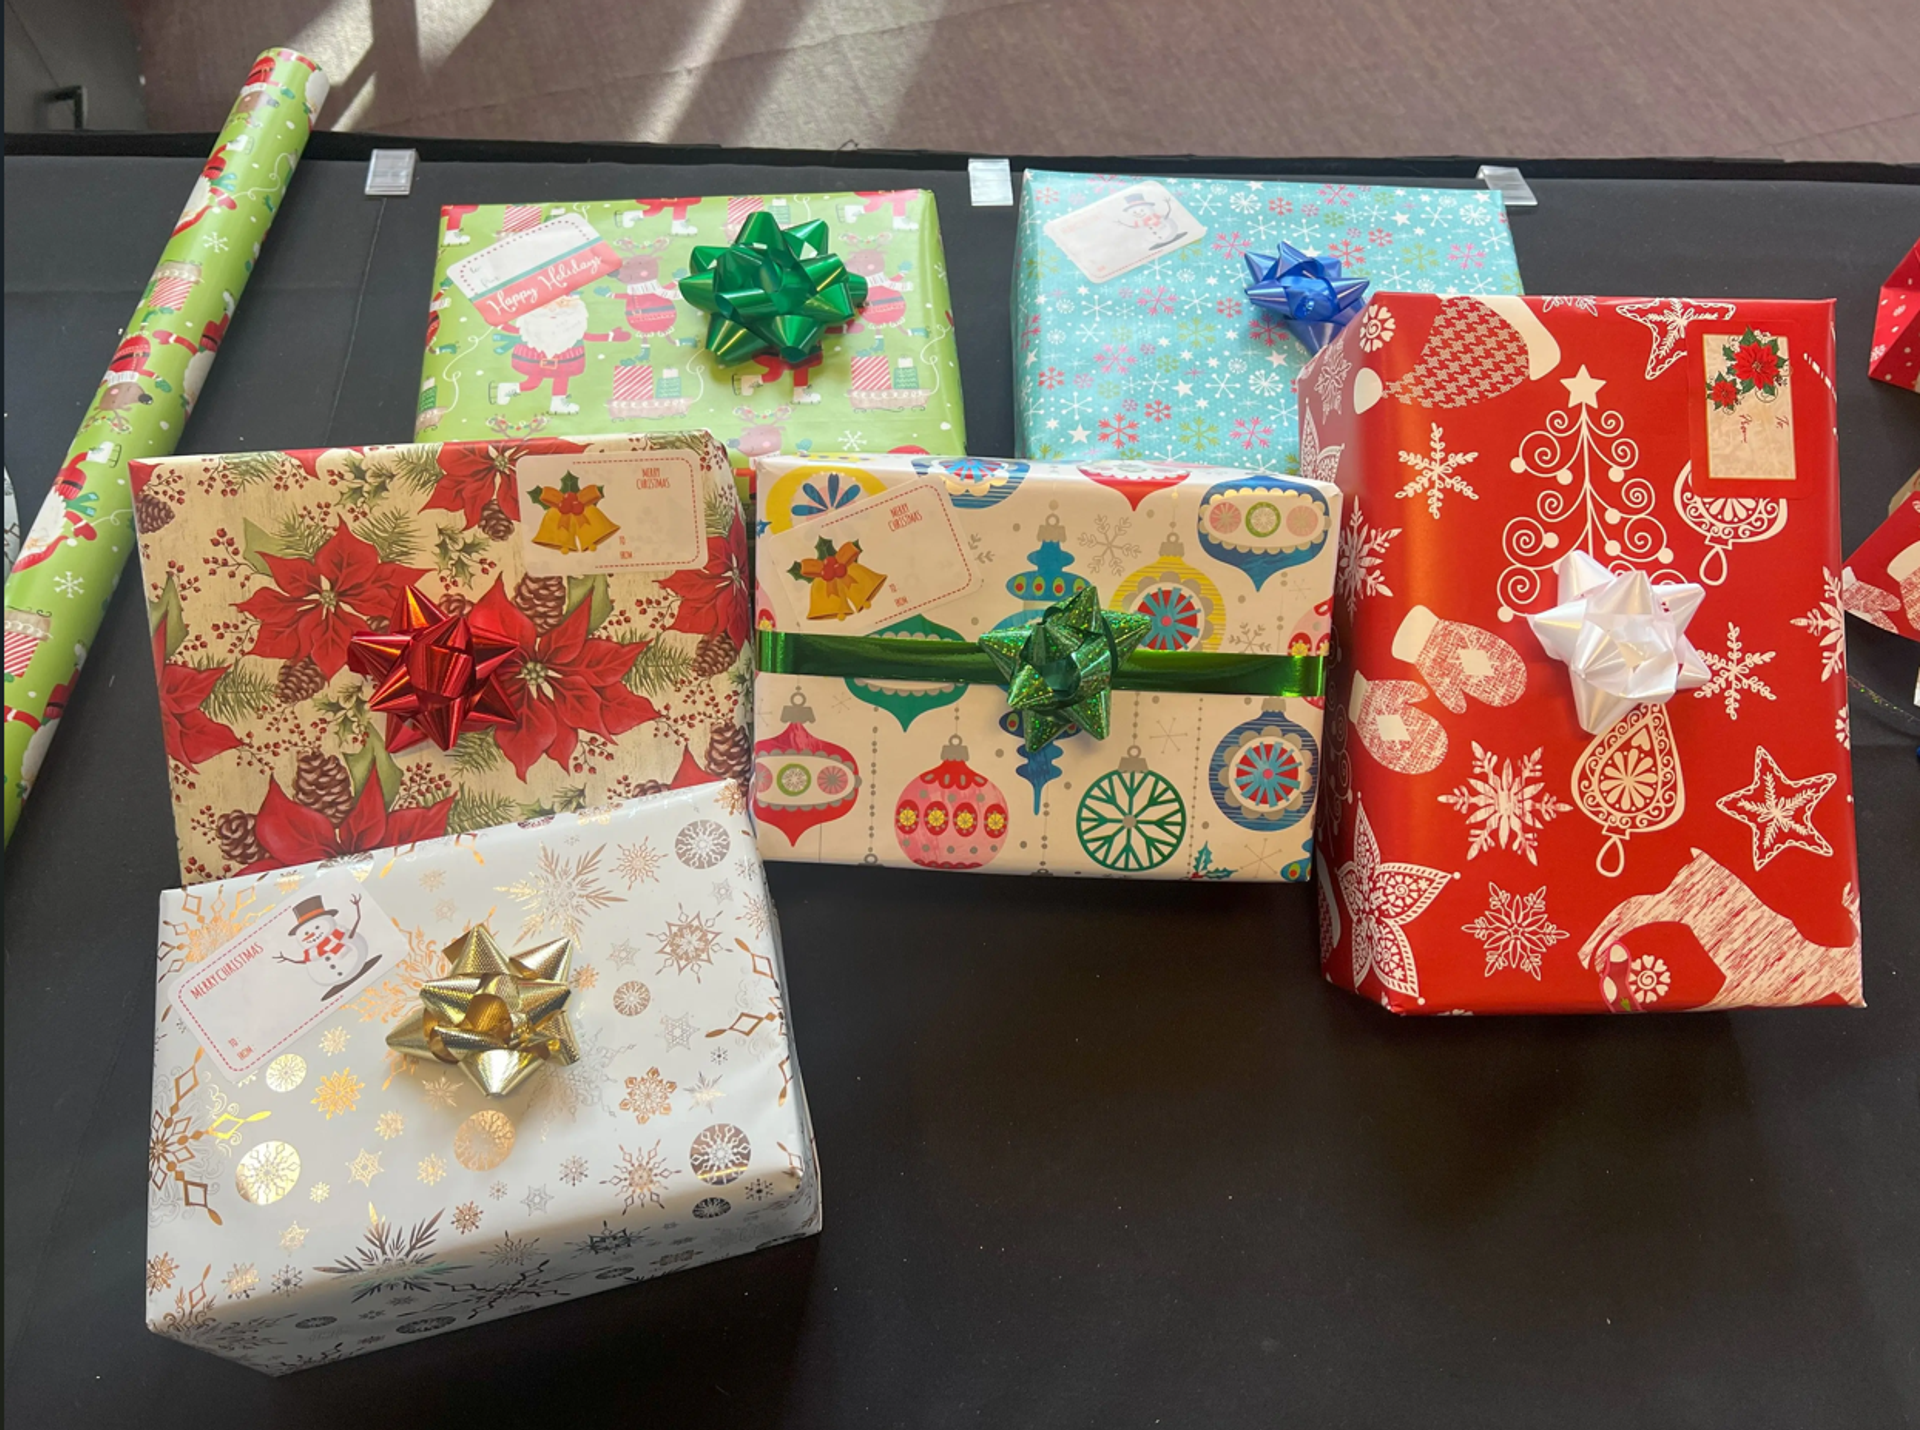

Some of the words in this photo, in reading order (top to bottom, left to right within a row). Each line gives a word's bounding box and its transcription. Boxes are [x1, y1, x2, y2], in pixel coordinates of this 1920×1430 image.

[486, 288, 539, 315] Happy
[538, 255, 602, 290] Holidays
[641, 467, 661, 478] MERRY
[636, 477, 670, 490] CHRISTMAS
[889, 502, 909, 518] MERRY
[887, 510, 923, 532] CHRISTMAS
[190, 973, 218, 1000] MERRY
[216, 941, 264, 982] CHRISTMAS
